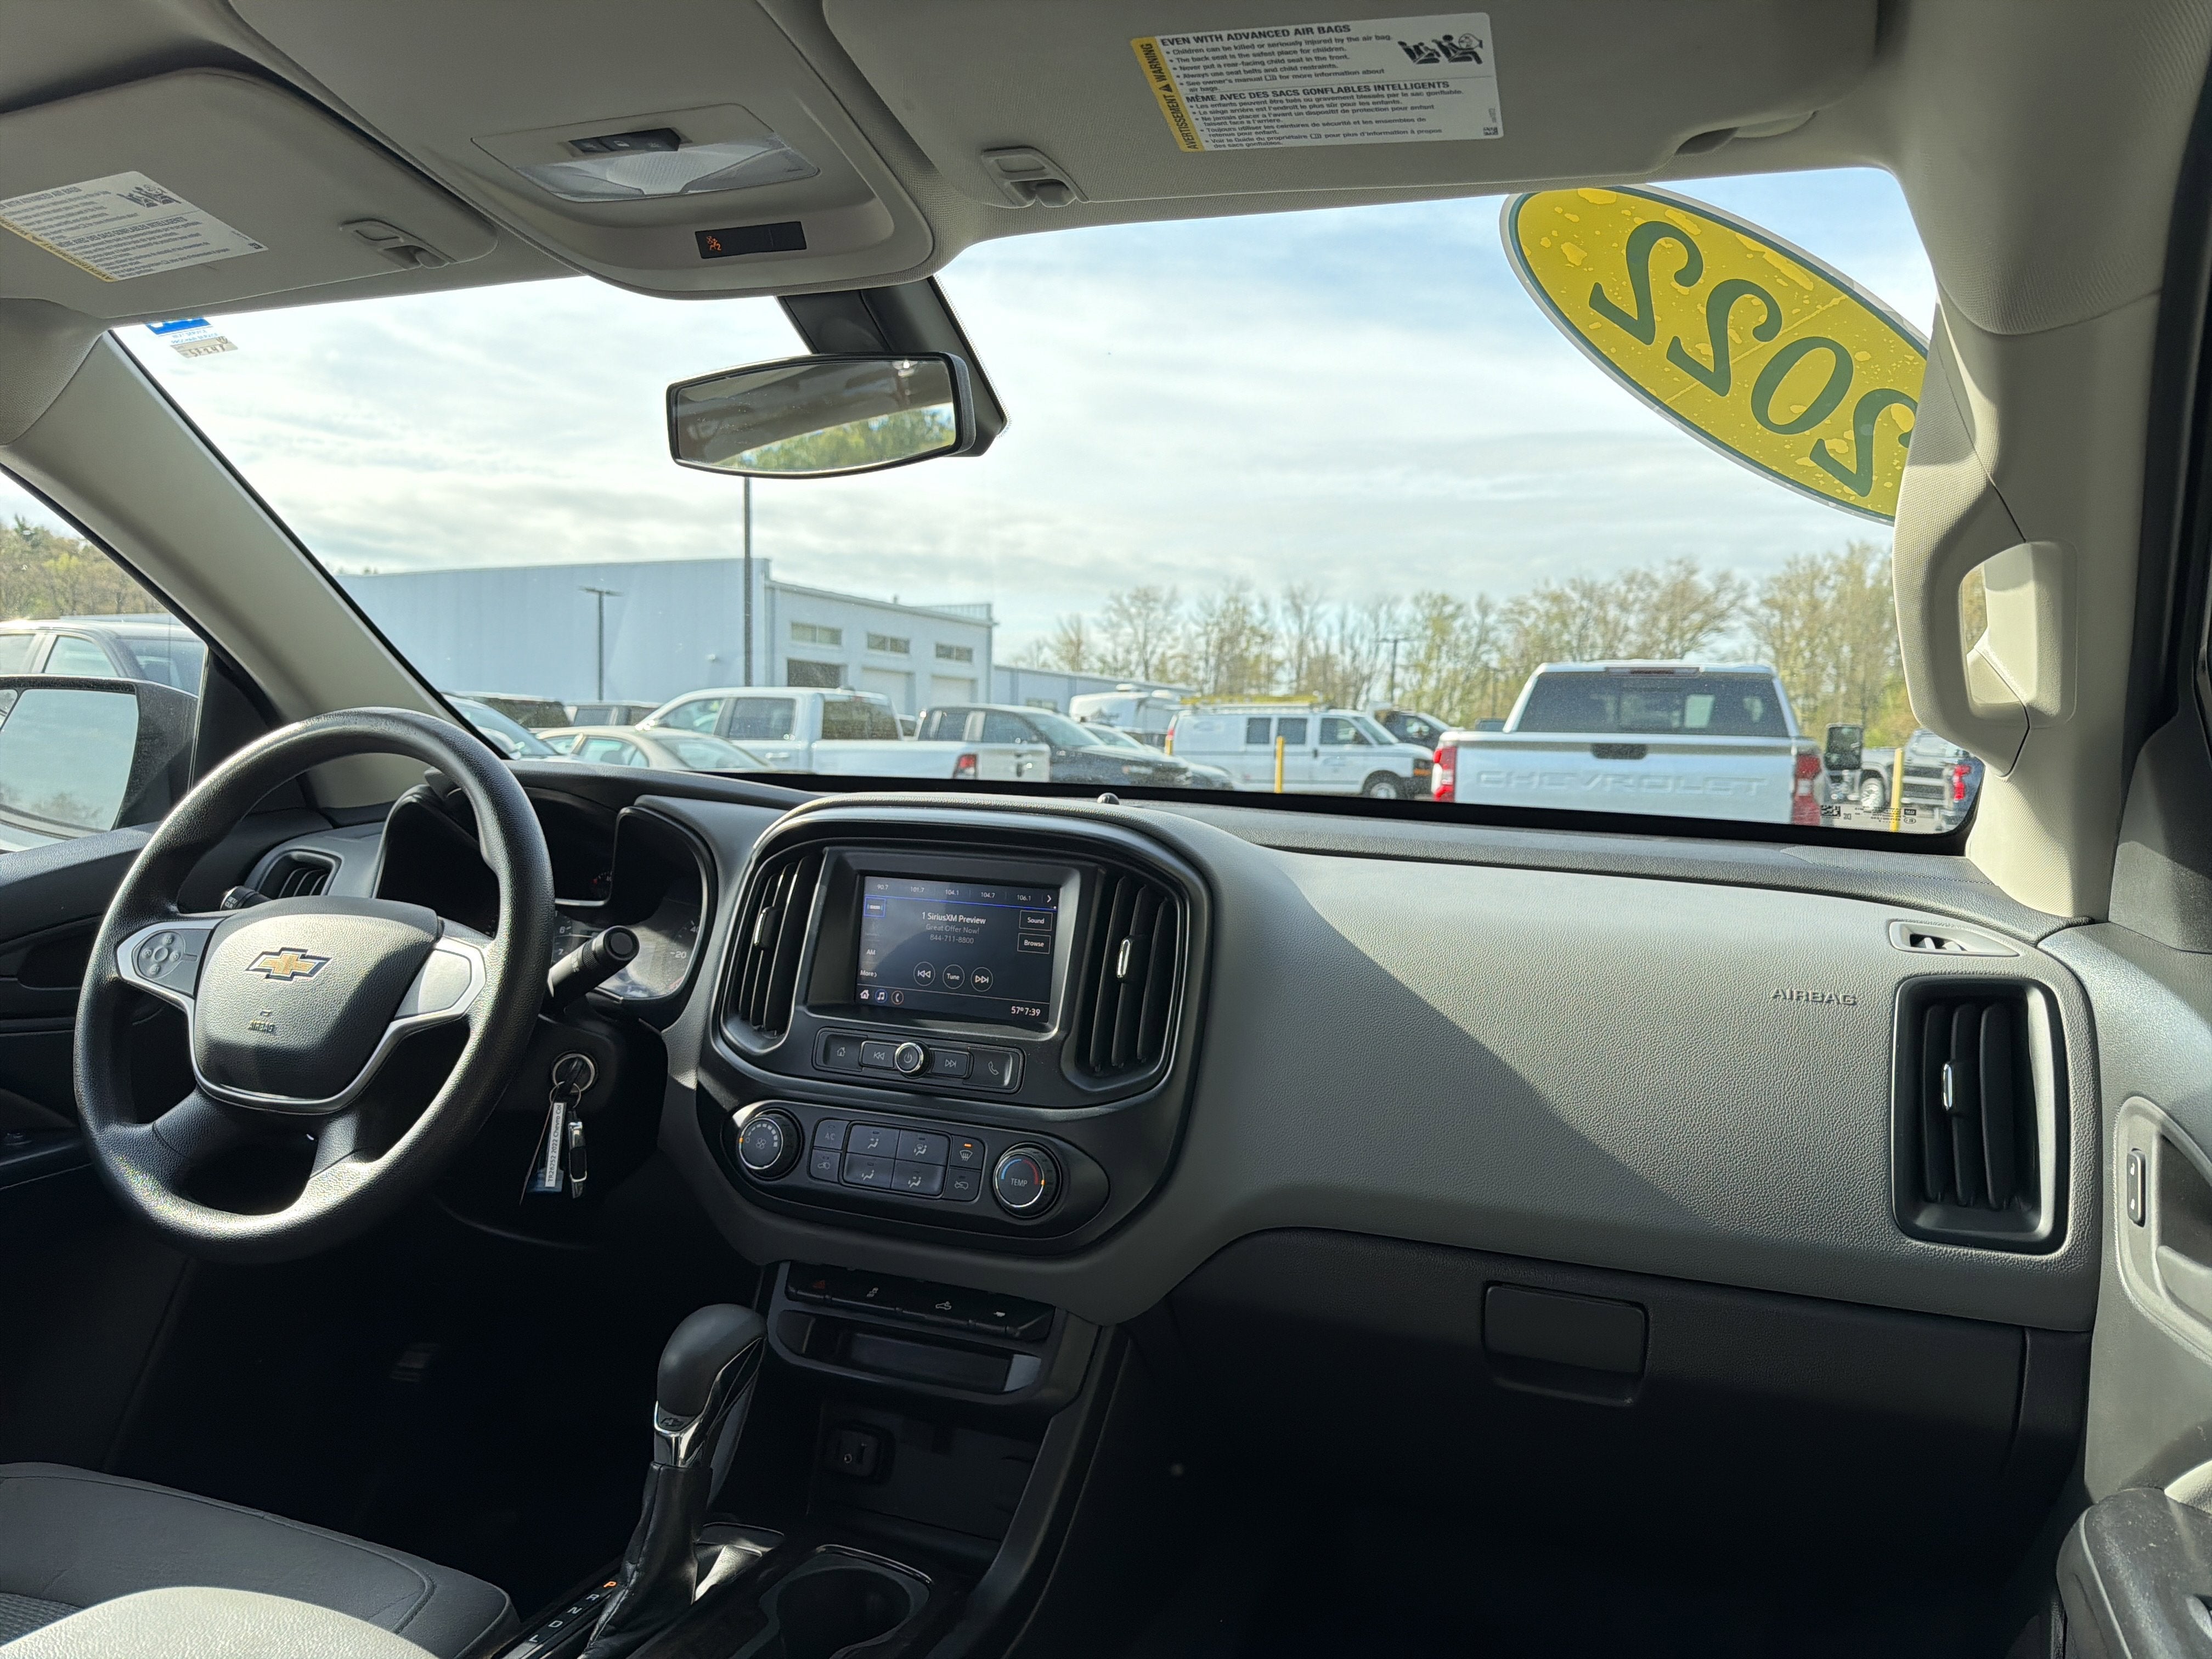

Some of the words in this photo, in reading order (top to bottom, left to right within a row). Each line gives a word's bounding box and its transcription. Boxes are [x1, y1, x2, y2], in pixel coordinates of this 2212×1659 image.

[1159, 36, 1190, 46] EVEN
[1192, 33, 1223, 43] WITH
[1226, 29, 1290, 41] ADVANCED
[1293, 27, 1314, 36] AIR
[1316, 24, 1351, 34] BAGS
[1141, 43, 1168, 83] WARNING
[1184, 94, 1217, 103] MÊME
[1219, 92, 1246, 101] AVEC
[1247, 91, 1269, 99] DES
[1271, 88, 1300, 97] SACS
[1301, 84, 1371, 95] GONFLABLES
[1373, 81, 1449, 91] INTELLIGENTS
[1163, 94, 1199, 150] AVERTISSEMENT
[1476, 770, 1765, 797] CHEVROLET
[922, 911, 926, 920] 1
[927, 912, 957, 922] SiriusXM
[958, 915, 986, 924] Preview
[930, 934, 974, 944] 844-711-8800
[1769, 988, 1858, 1006] AIRBAG
[548, 1155, 556, 1183] TR26252
[1011, 1178, 1028, 1187] TEMP
[528, 1634, 539, 1643] L
